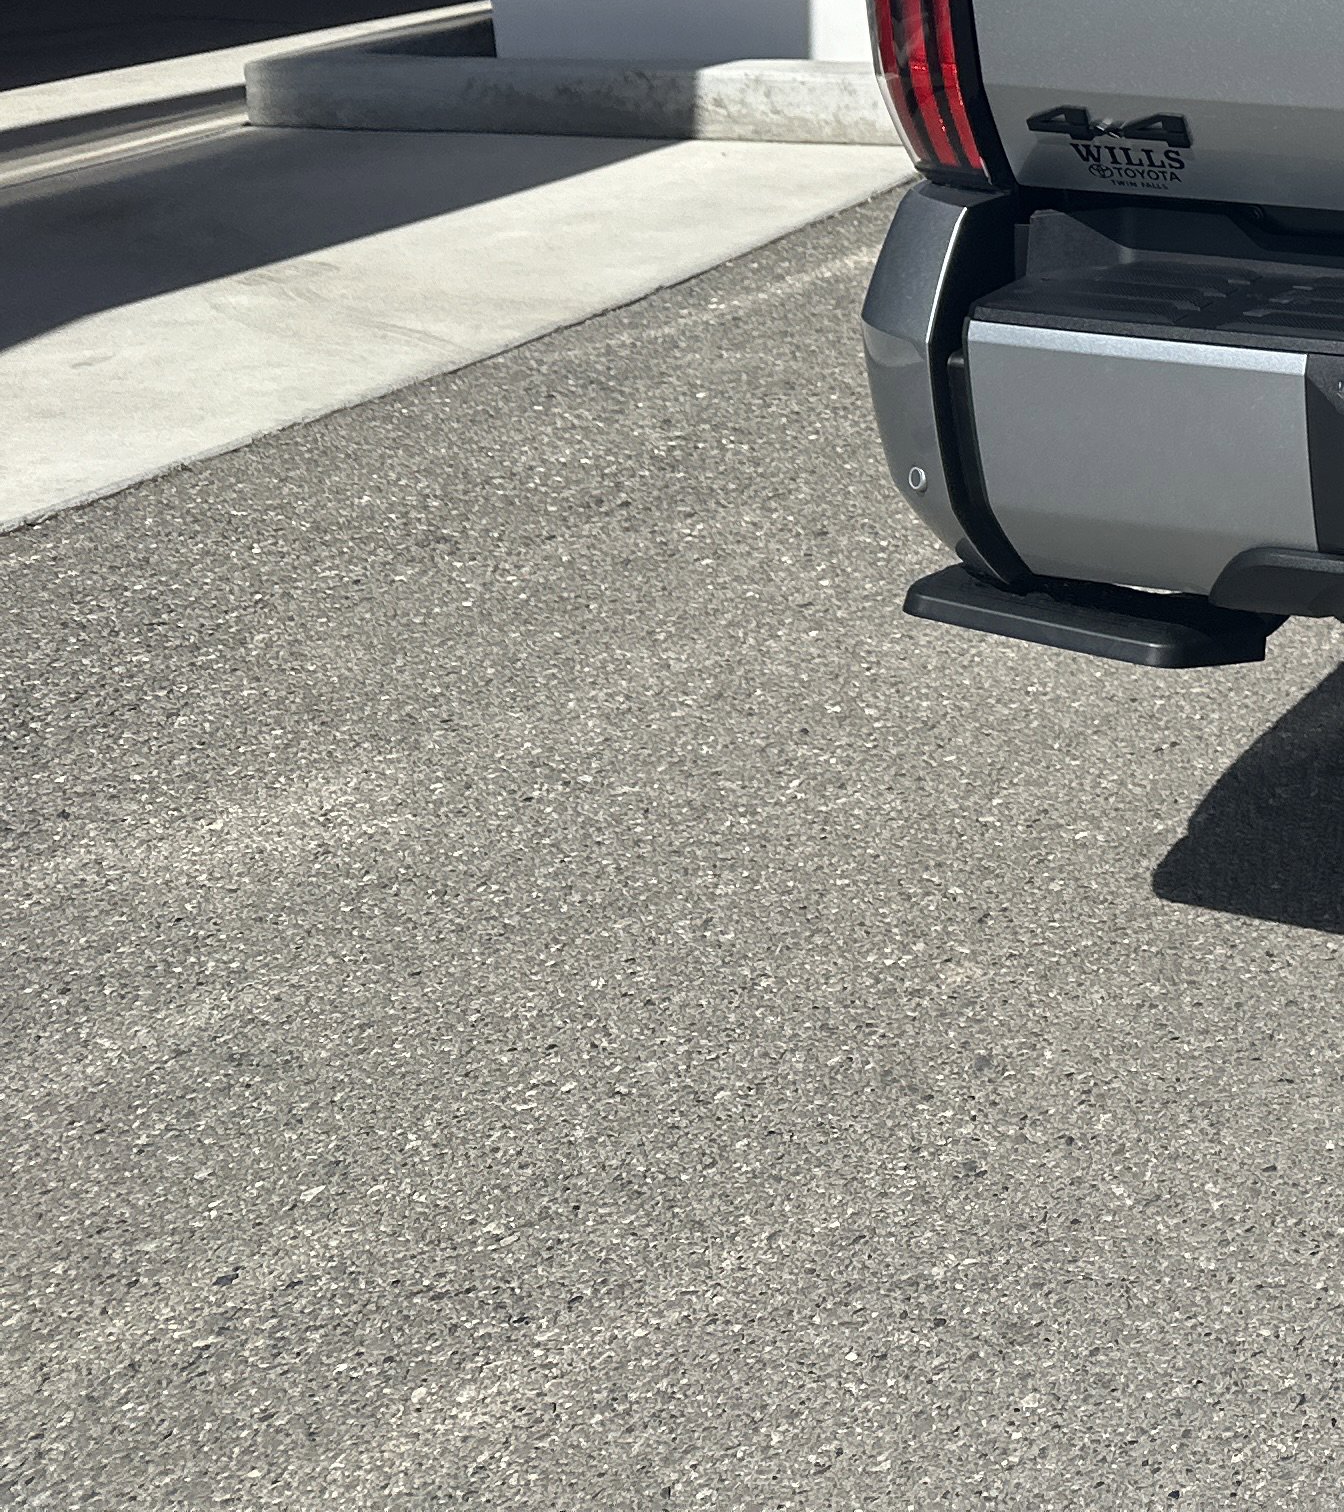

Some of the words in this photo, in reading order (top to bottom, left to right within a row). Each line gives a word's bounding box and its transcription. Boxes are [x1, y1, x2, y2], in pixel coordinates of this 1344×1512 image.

[1069, 142, 1186, 170] WILLS
[1116, 166, 1182, 183] TOYOTA
[1111, 179, 1138, 188] TWIN
[1140, 181, 1169, 190] FALLS
